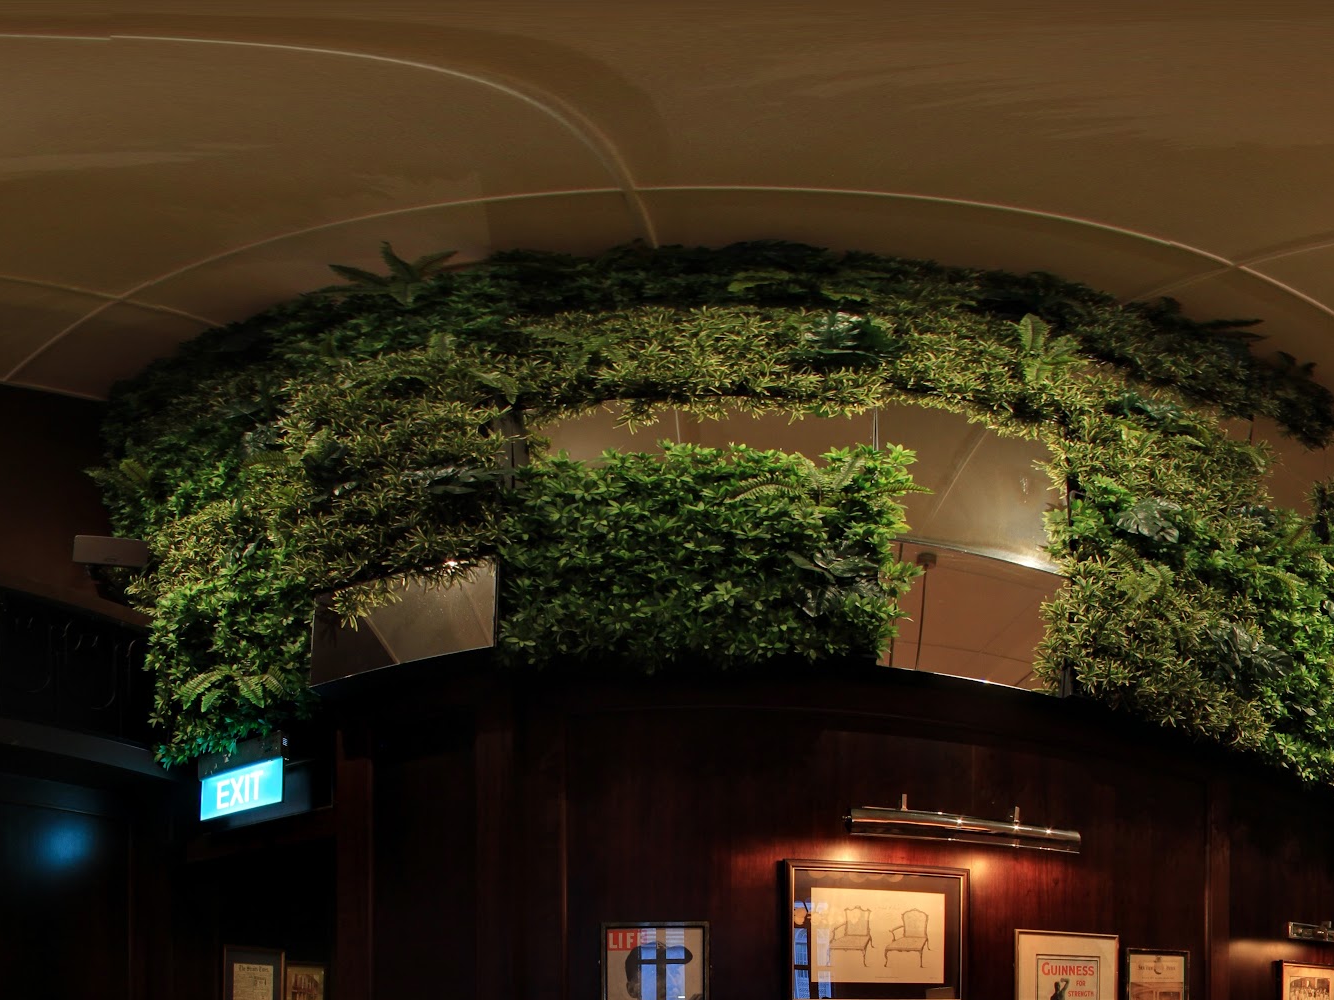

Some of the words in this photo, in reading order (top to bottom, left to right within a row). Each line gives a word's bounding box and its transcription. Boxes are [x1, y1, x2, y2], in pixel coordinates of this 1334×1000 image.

[216, 769, 264, 810] EXIT
[1041, 961, 1095, 976] GUINNESS
[1067, 990, 1095, 998] STRENGTH
